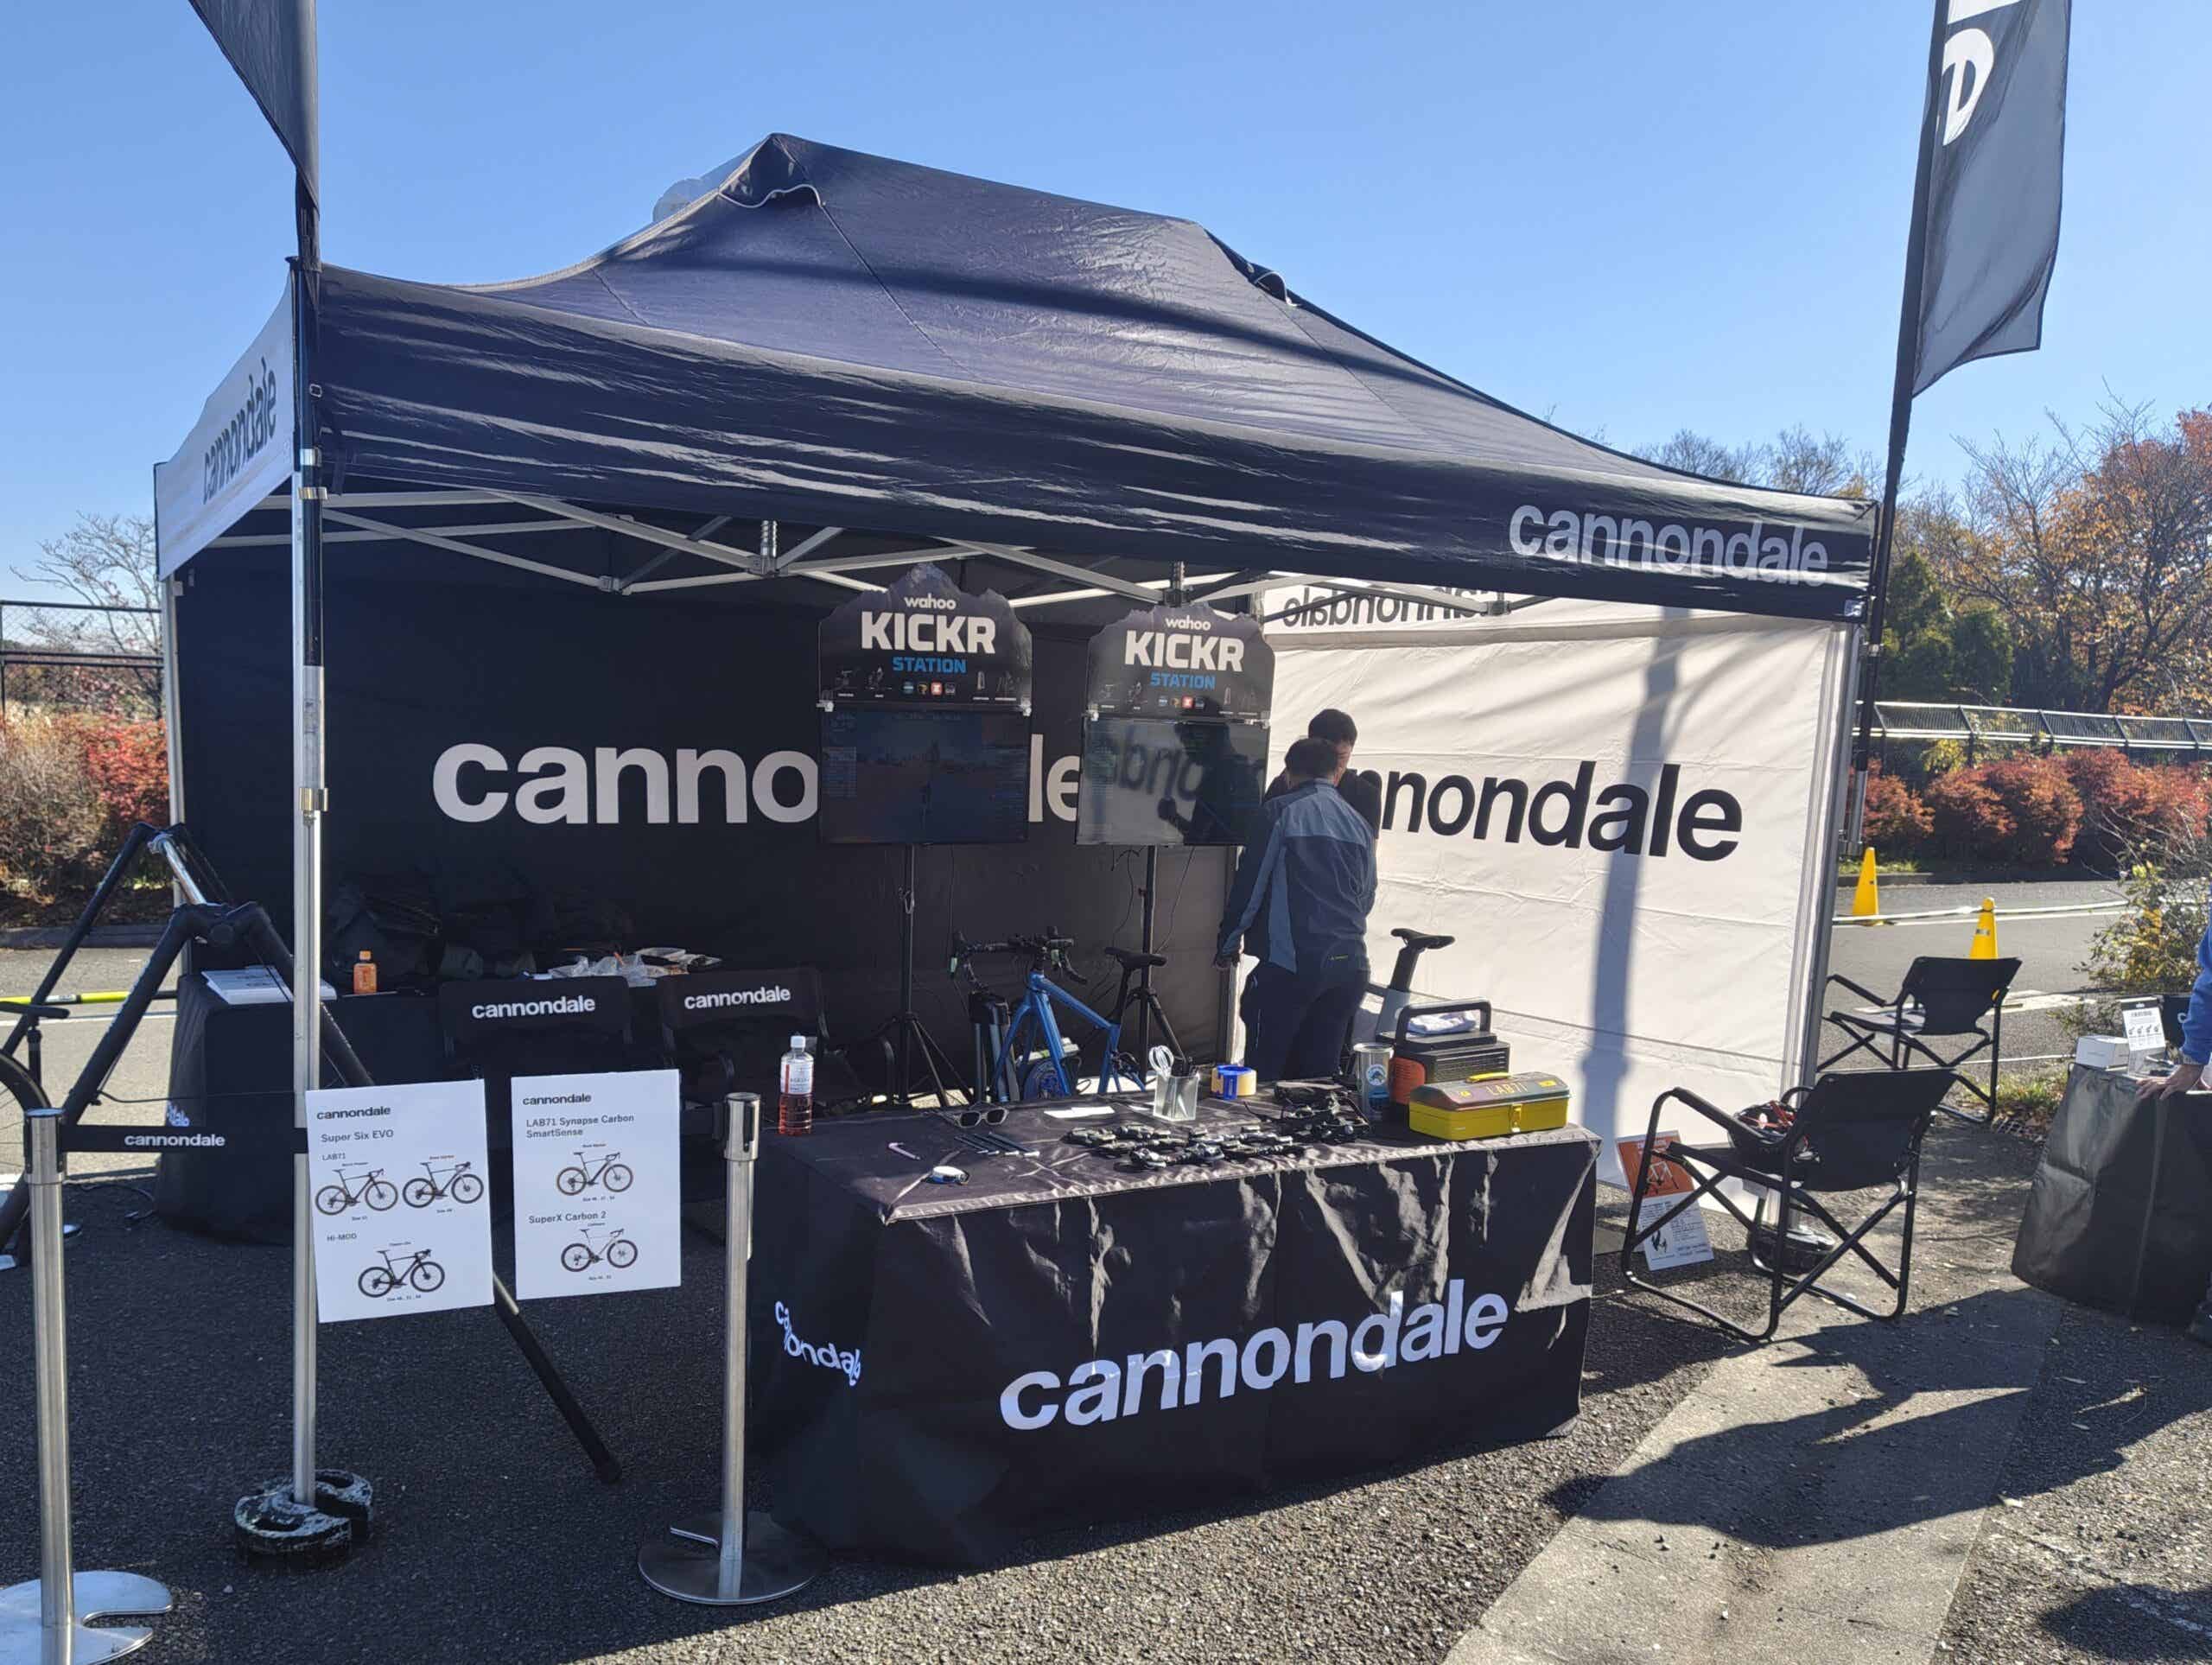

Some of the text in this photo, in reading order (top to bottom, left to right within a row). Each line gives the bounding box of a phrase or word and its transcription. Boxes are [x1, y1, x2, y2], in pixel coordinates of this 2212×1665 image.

[203, 356, 276, 505] cannondale
[1509, 505, 1828, 587] cannondale
[904, 593, 957, 610] wahoo
[1166, 615, 1211, 631] wahoo
[861, 611, 995, 654] KICKR
[1124, 630, 1244, 672] KICKR
[893, 656, 967, 673] STATION
[1150, 672, 1216, 690] STATION
[1345, 760, 1743, 862] nondale
[684, 985, 791, 1010] cannondale
[472, 995, 596, 1020] cannondale
[523, 1092, 592, 1106] cannondale
[316, 1105, 391, 1120] cannondale
[526, 1114, 634, 1128] LAB71 Synapse Carbon
[124, 1133, 226, 1147] cannondale
[321, 1128, 394, 1144] Super Six EVO
[526, 1128, 583, 1138] SmartSense
[529, 1211, 607, 1224] SuperX Carbon 2
[1000, 1279, 1509, 1431] cannondale
